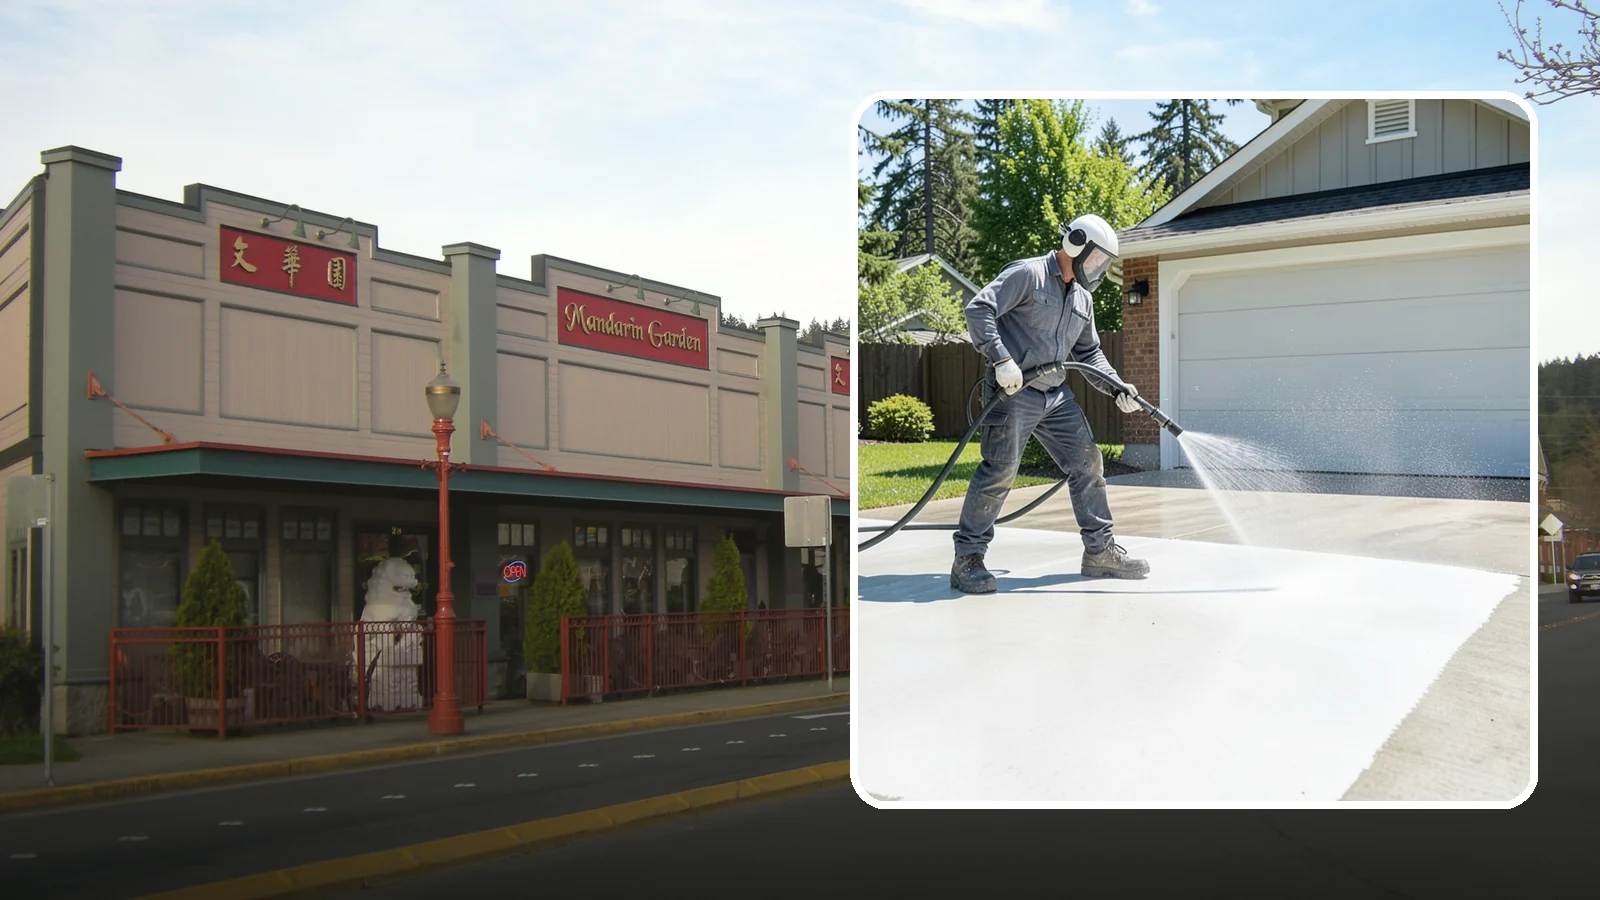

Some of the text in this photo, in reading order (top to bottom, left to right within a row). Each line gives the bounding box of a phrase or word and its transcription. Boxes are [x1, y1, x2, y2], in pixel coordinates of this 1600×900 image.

[564, 302, 701, 352] Mandarin Garden
[503, 565, 527, 578] OPEN
